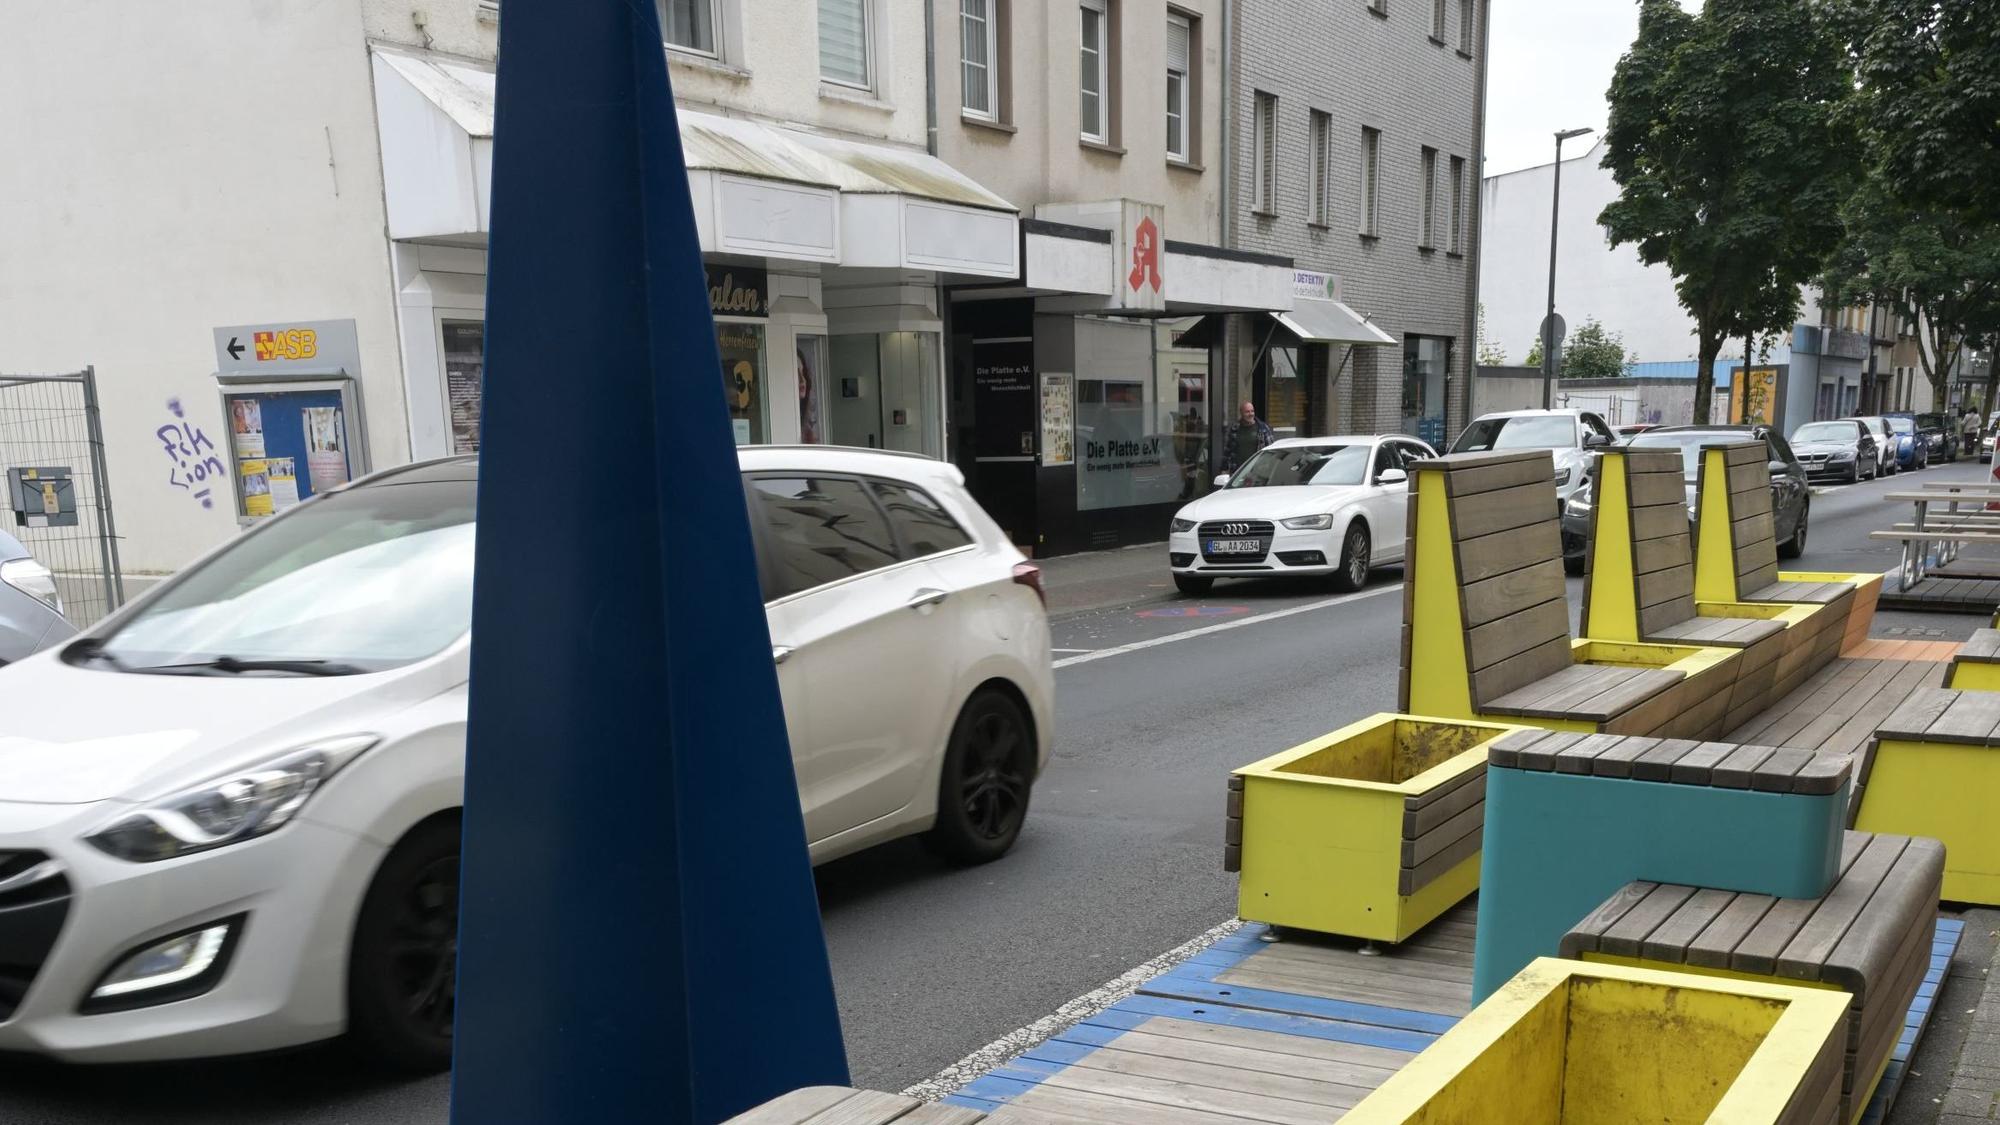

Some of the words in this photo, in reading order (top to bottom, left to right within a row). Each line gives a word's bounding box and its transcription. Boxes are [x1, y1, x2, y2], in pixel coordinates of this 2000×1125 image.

[1297, 272, 1325, 286] DETEKTIV
[704, 271, 760, 312] alon
[271, 328, 317, 360] ASB
[976, 367, 989, 375] Die
[991, 366, 1014, 374] Platte
[1087, 441, 1105, 458] Die
[1108, 440, 1140, 457] Platte
[1228, 541, 1238, 551] AA
[1239, 541, 1259, 551] 2034
